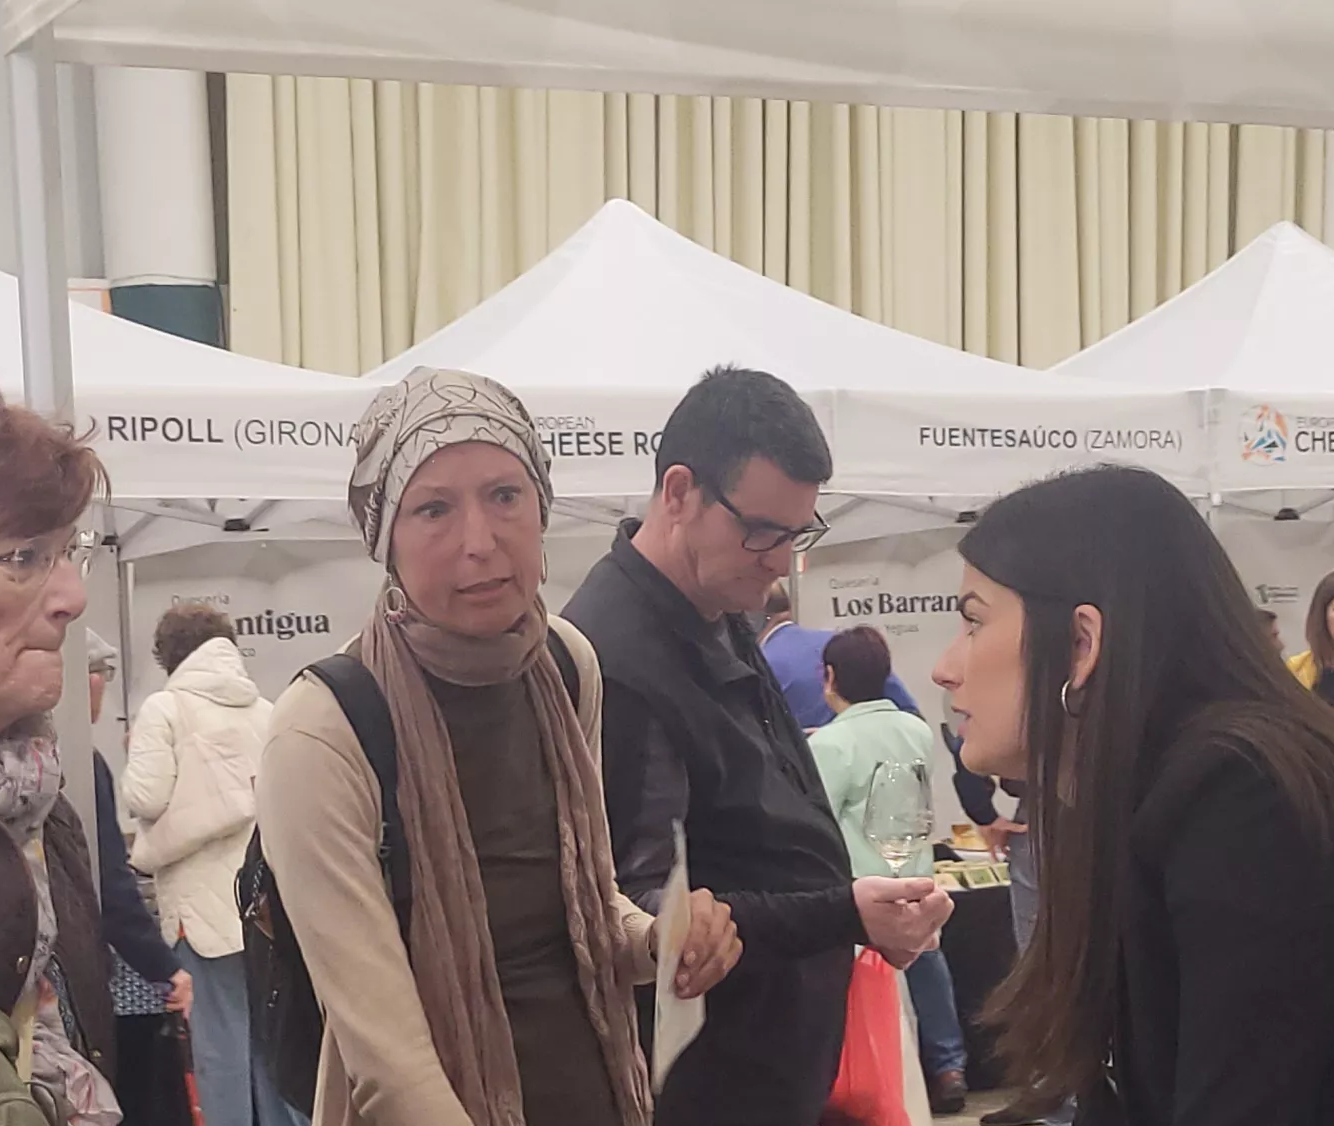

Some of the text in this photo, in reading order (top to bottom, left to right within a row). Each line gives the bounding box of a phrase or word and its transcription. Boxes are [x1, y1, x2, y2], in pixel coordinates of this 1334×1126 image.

[107, 415, 361, 451] RIPOLL (GIRONA
[535, 416, 596, 430] ROPEAN
[538, 431, 625, 457] HEESE
[919, 425, 1184, 453] FUENTESAÚCO (ZAMORA)
[831, 593, 961, 618] Los Barran
[234, 609, 331, 641] ntigua
